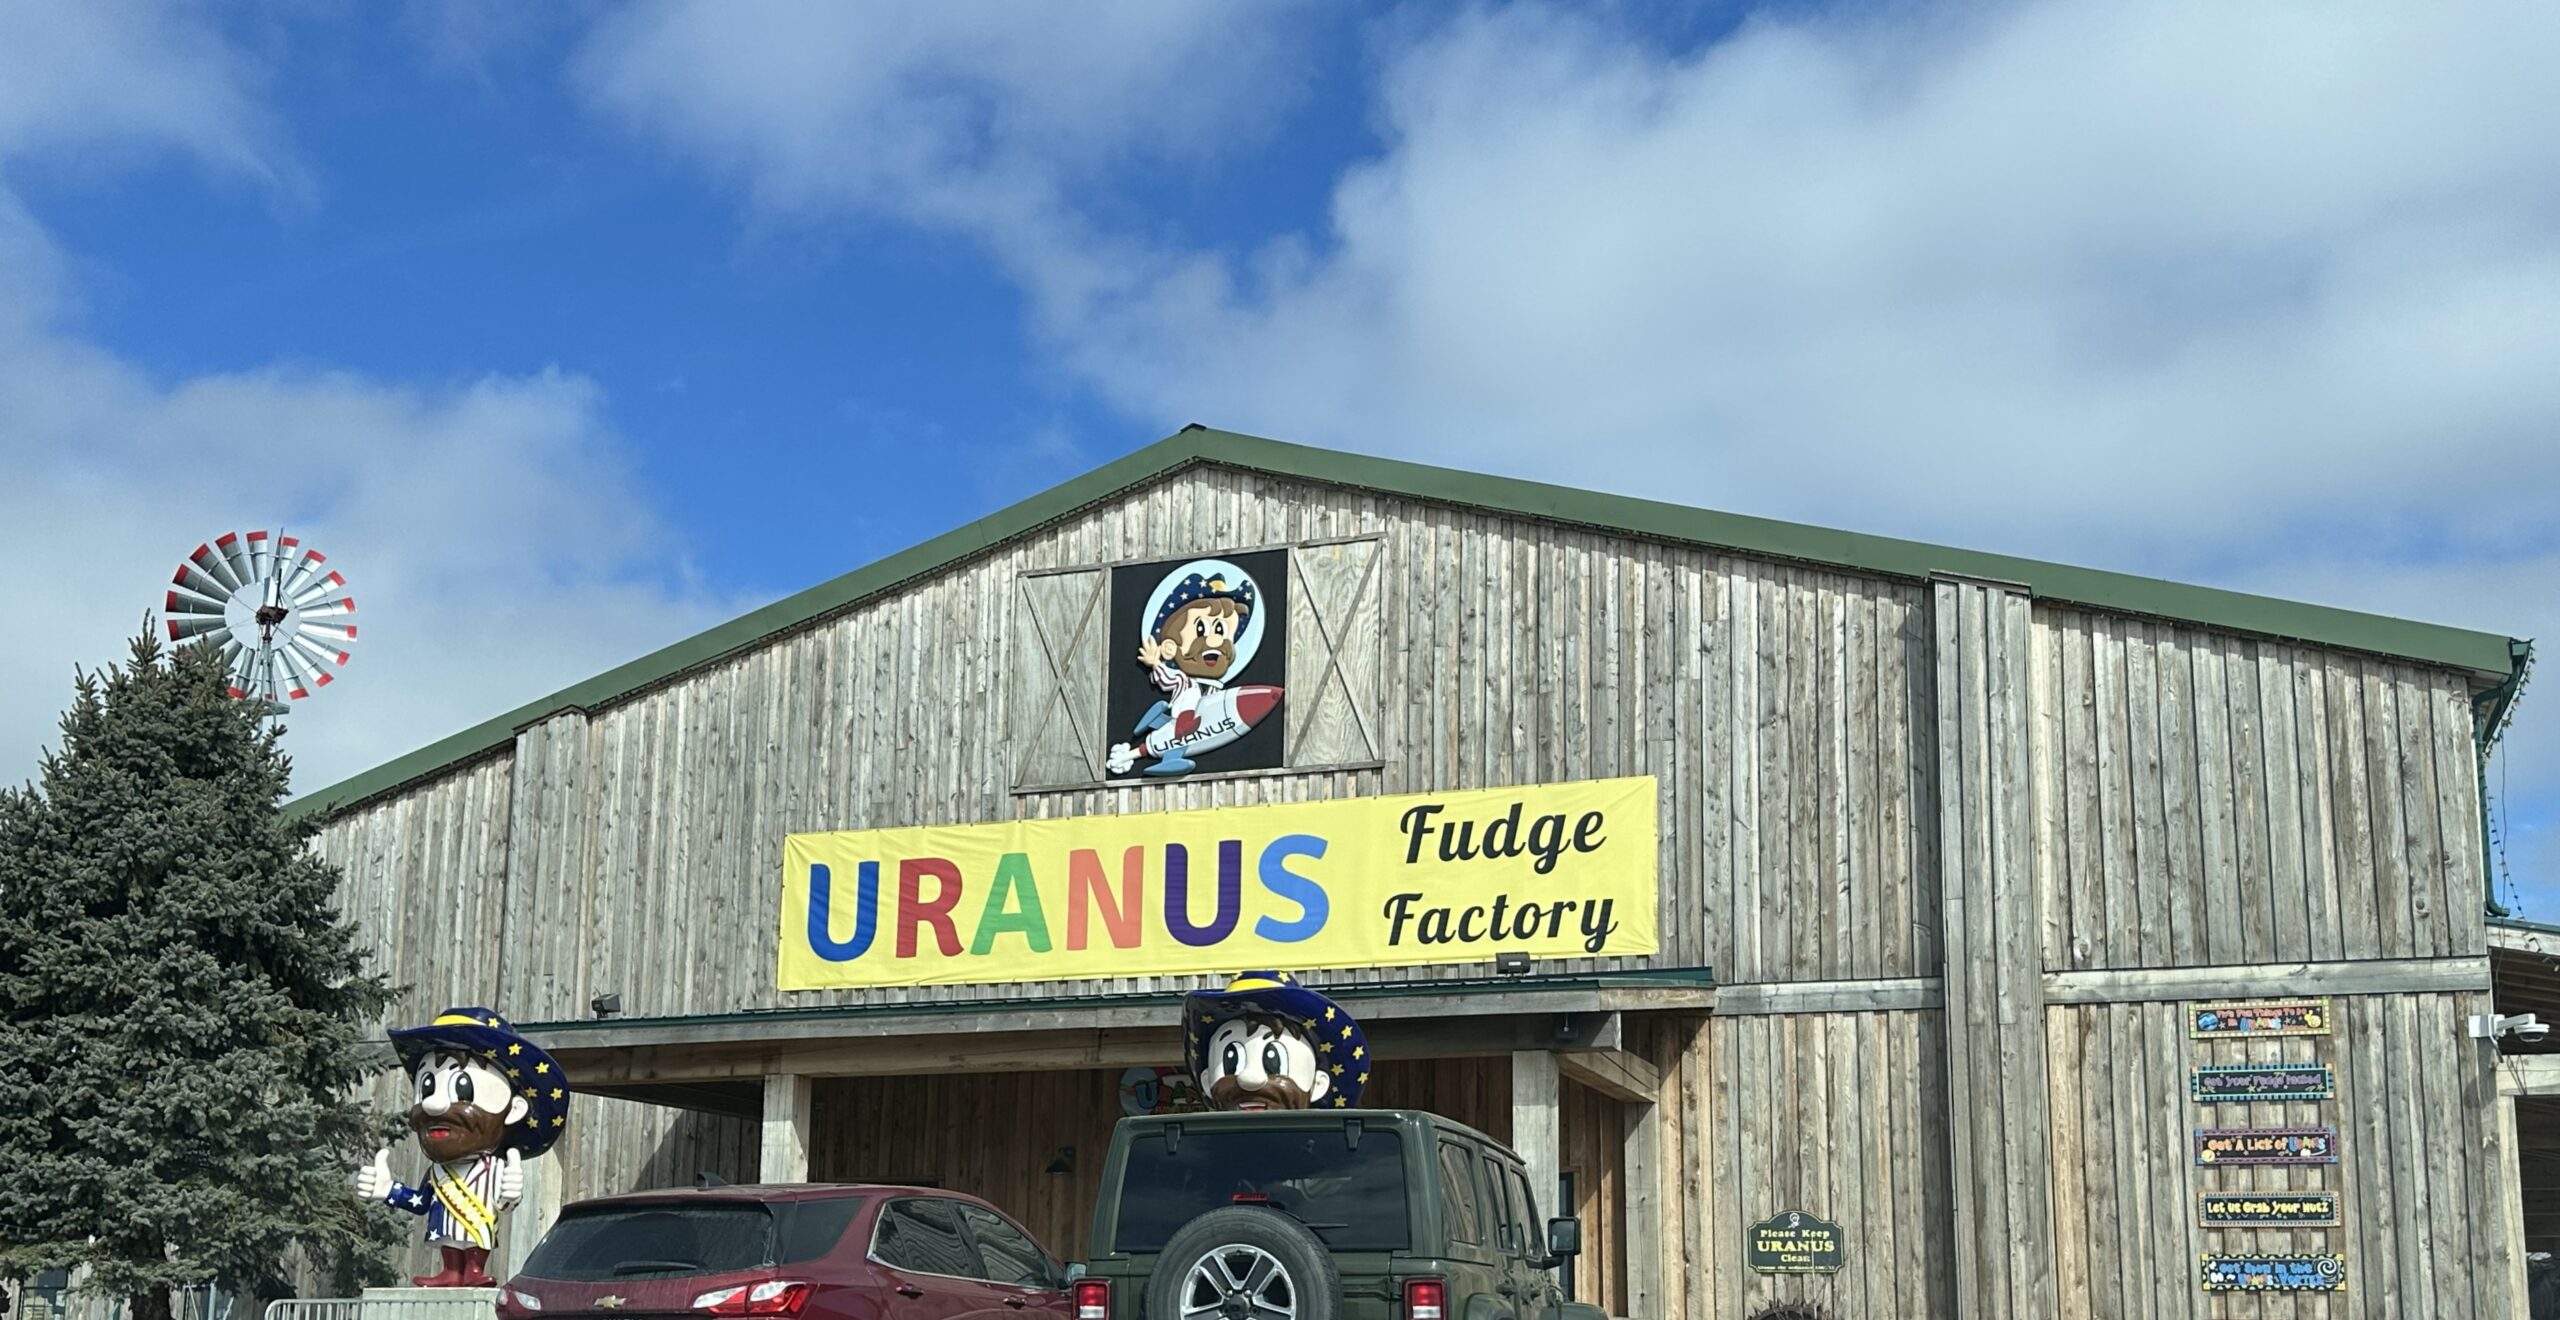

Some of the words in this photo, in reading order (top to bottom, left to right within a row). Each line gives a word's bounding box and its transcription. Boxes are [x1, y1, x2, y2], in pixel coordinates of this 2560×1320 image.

[1154, 717, 1235, 752] URANUS
[1400, 802, 1607, 874] Fudge
[807, 834, 1329, 961] URANUS
[1384, 893, 1618, 953] Factory
[2253, 1008, 2282, 1018] Things
[2283, 1007, 2295, 1016] To
[2225, 1075, 2251, 1087] Your
[2208, 1138, 2232, 1151] Get
[2235, 1138, 2245, 1151] A
[2247, 1137, 2273, 1151] Lick
[2207, 1201, 2226, 1214] Let
[2242, 1202, 2270, 1214] Grab
[2271, 1200, 2300, 1216] Your
[1760, 1229, 1796, 1238] Please
[1801, 1229, 1830, 1239] Keep
[1757, 1240, 1835, 1252] URANUS
[1780, 1253, 1811, 1262] Clean
[2219, 1262, 2241, 1273] Get
